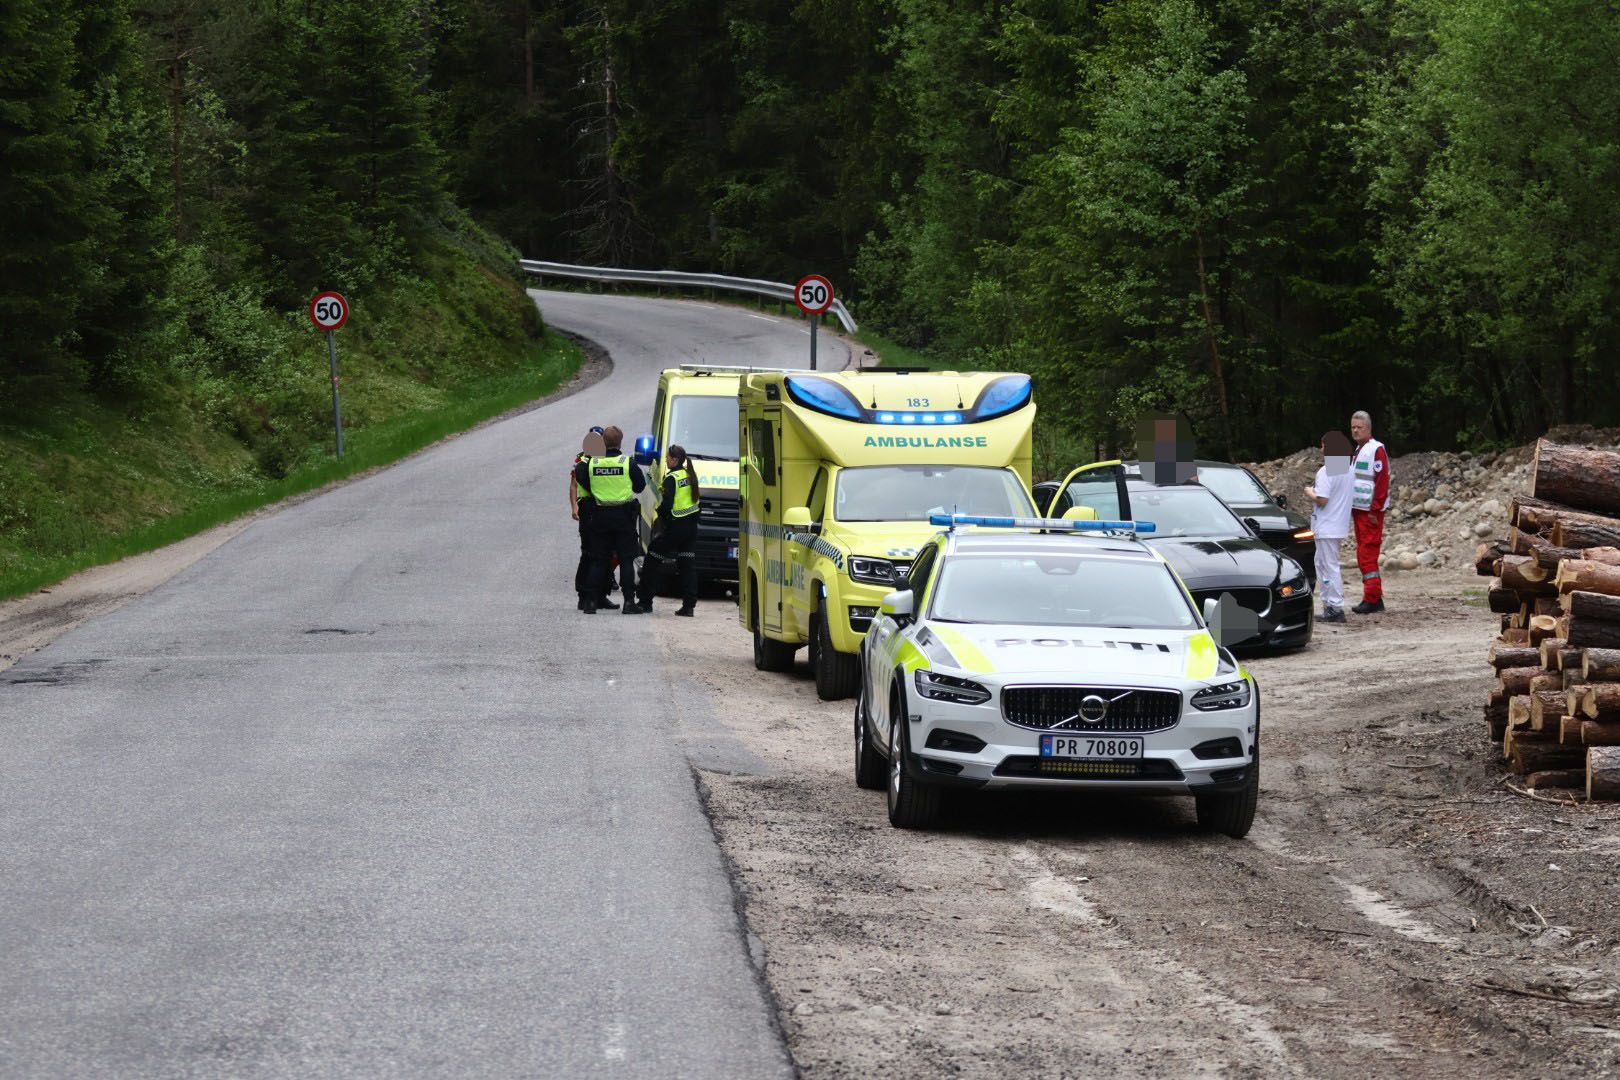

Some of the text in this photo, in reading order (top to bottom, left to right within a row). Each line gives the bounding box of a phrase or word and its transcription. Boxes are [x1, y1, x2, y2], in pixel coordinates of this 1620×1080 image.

[801, 285, 827, 304] 50
[317, 302, 342, 321] 50
[906, 398, 930, 408] 183
[864, 436, 988, 448] AMBULANSE
[595, 467, 620, 476] POLITI
[699, 475, 738, 486] AMB
[994, 638, 1170, 653] POLITI
[1056, 739, 1139, 756] PR 70809
